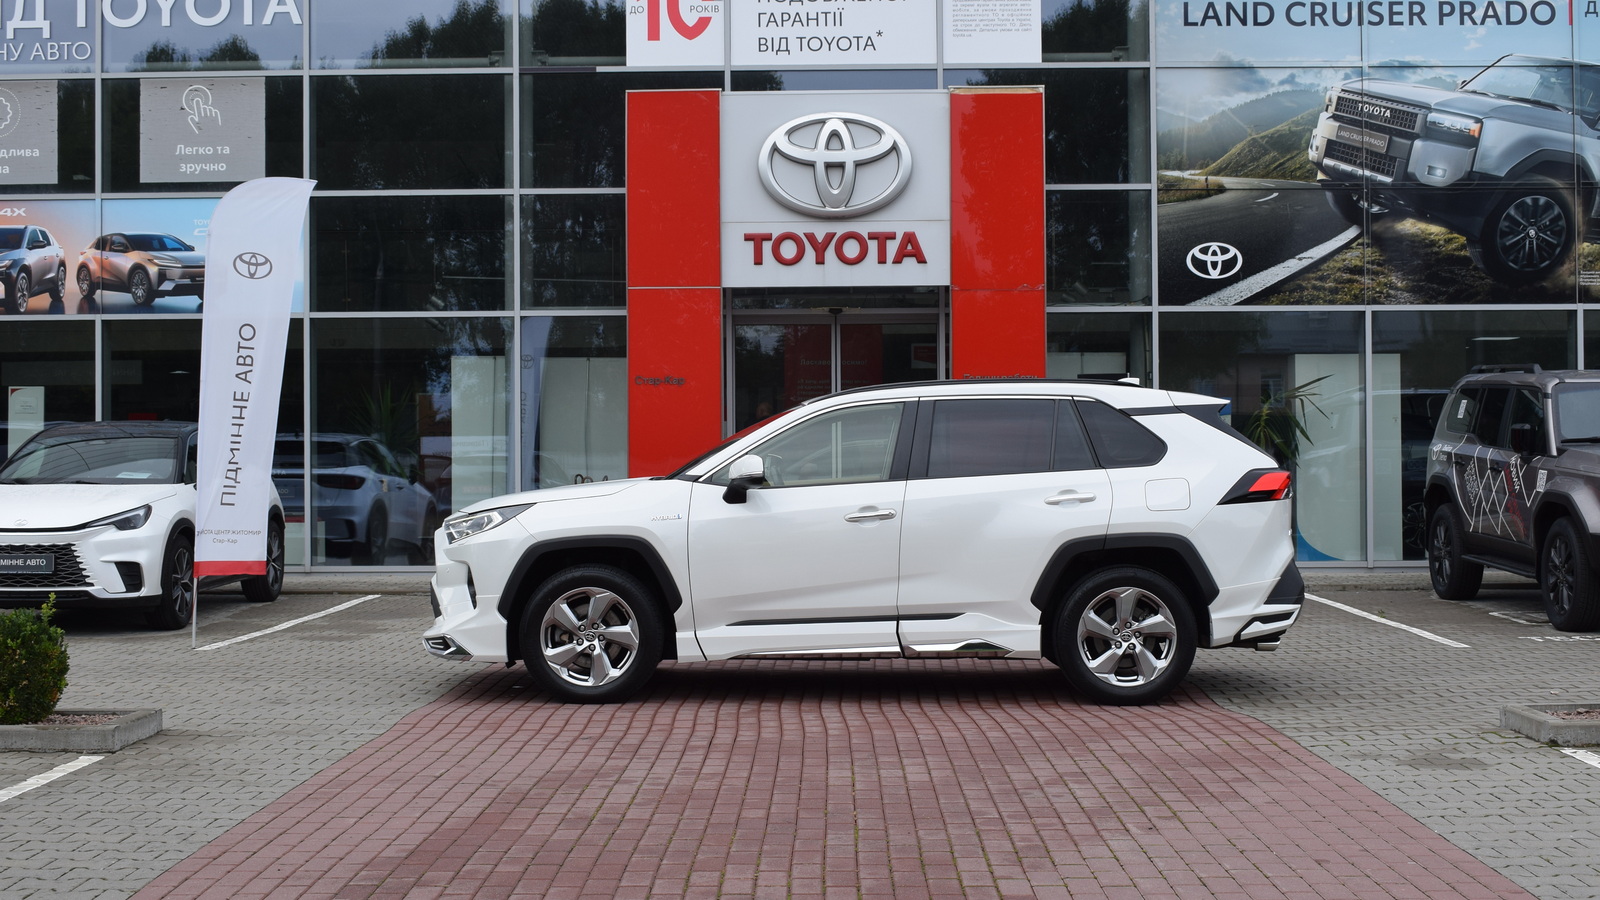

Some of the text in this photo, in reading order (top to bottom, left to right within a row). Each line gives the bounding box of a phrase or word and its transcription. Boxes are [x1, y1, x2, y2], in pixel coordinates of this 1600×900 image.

[629, 5, 645, 15] ДО
[689, 5, 720, 13] РОКІВ
[757, 8, 844, 27] ГАРАНТІЇ
[1183, 1, 1275, 26] LAND
[1285, 1, 1427, 26] CRUISER
[1438, 1, 1556, 26] PRADO
[0, 0, 50, 39] Д
[30, 41, 91, 60] АВТО
[758, 37, 790, 55] ВІД
[1358, 103, 1391, 118] TOYOTA
[1338, 129, 1385, 147] LAND CRUISER PRADO
[175, 144, 230, 155] Легко та
[179, 163, 227, 174] зручно
[744, 231, 928, 266] TOYOTA
[635, 375, 686, 387] Стар-Кар
[220, 323, 256, 506] ПІДМІННЕ АВТО
[26, 558, 47, 566] АВТО
